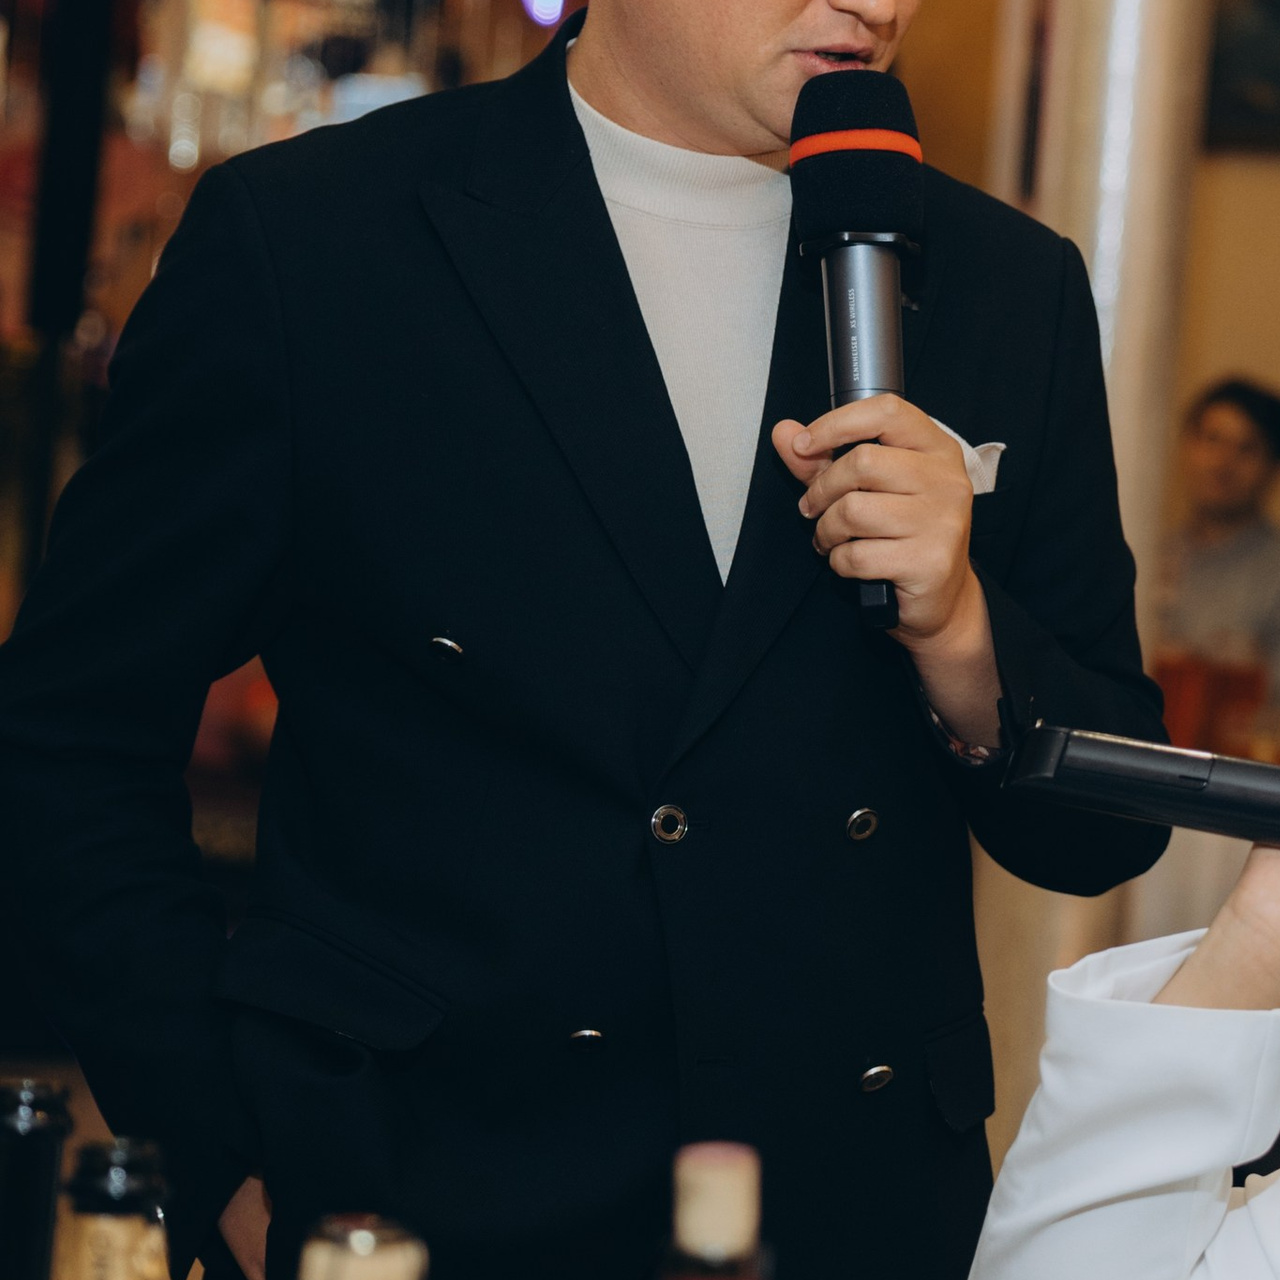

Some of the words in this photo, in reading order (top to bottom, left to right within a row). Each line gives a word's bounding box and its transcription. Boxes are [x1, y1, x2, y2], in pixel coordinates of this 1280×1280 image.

[848, 287, 856, 319] WIRELESS
[850, 319, 857, 329] XS
[851, 335, 860, 381] SENNHEISER
